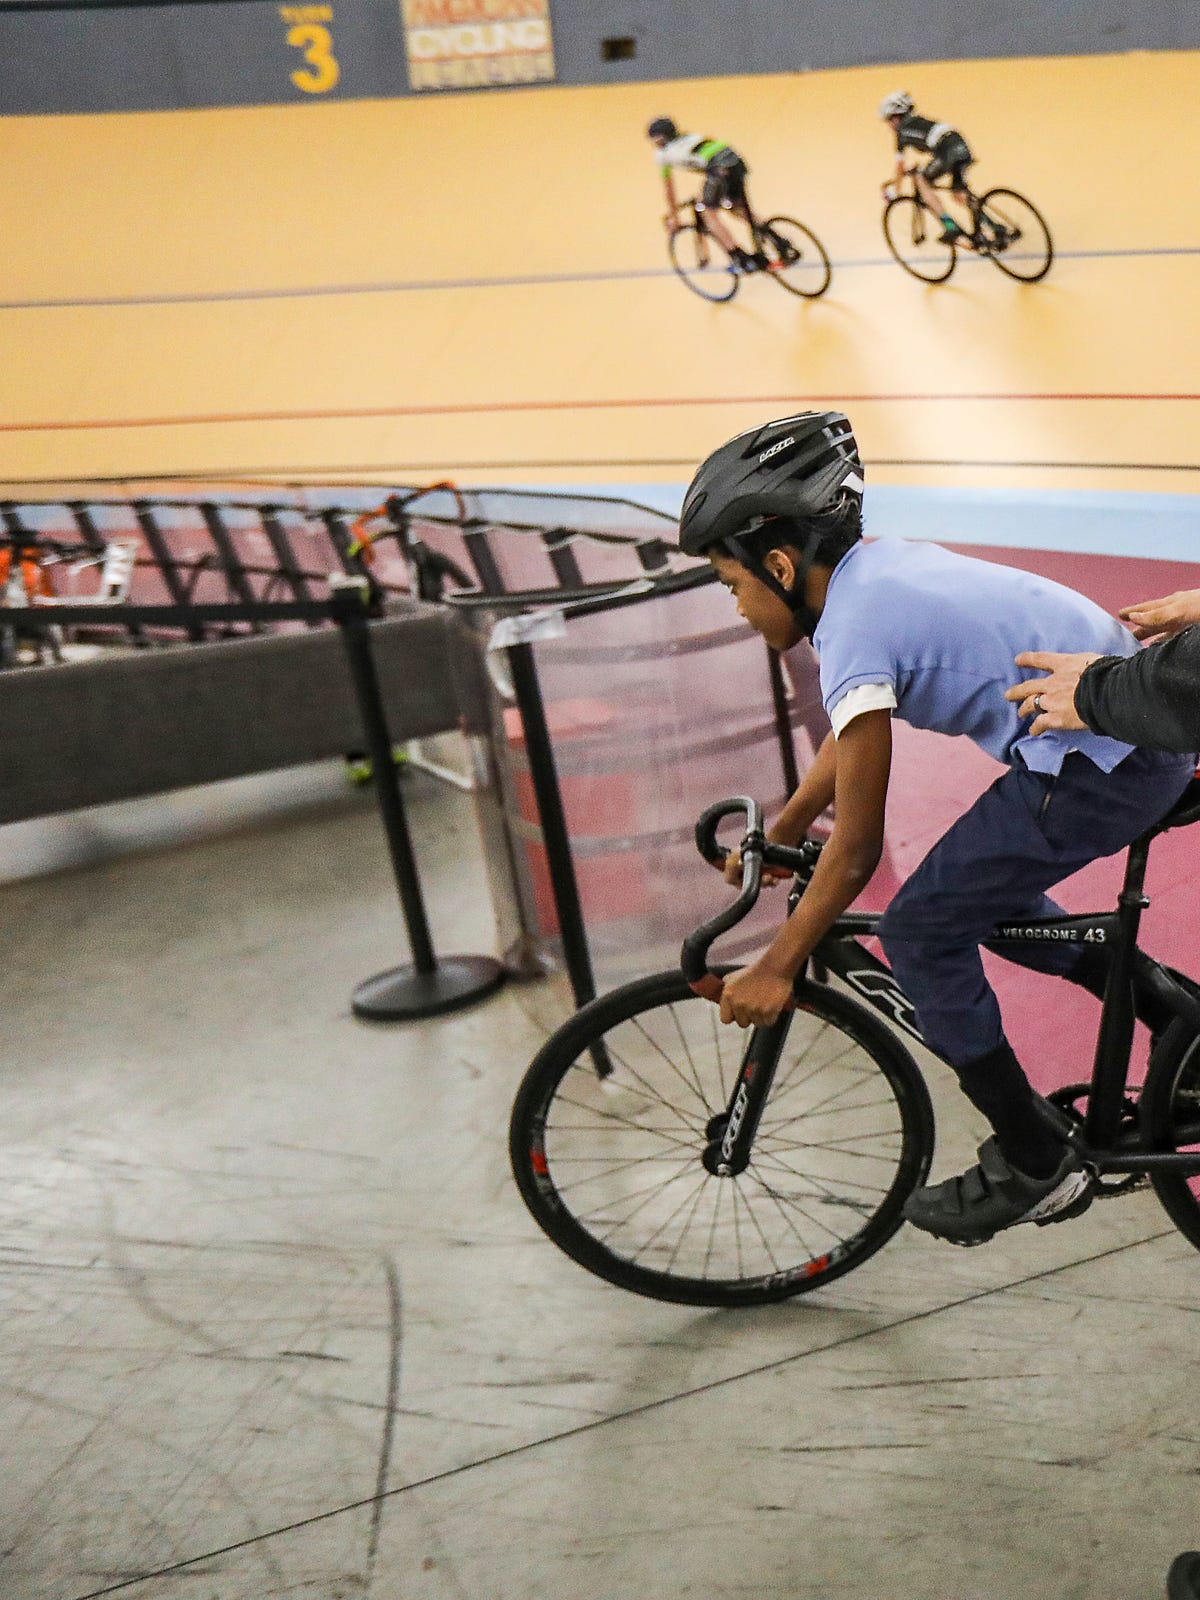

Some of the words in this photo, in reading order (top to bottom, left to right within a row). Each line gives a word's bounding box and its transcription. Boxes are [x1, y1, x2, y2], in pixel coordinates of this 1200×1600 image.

[288, 25, 340, 94] 3
[1002, 927, 1078, 941] VELODROME
[1083, 927, 1107, 943] 43
